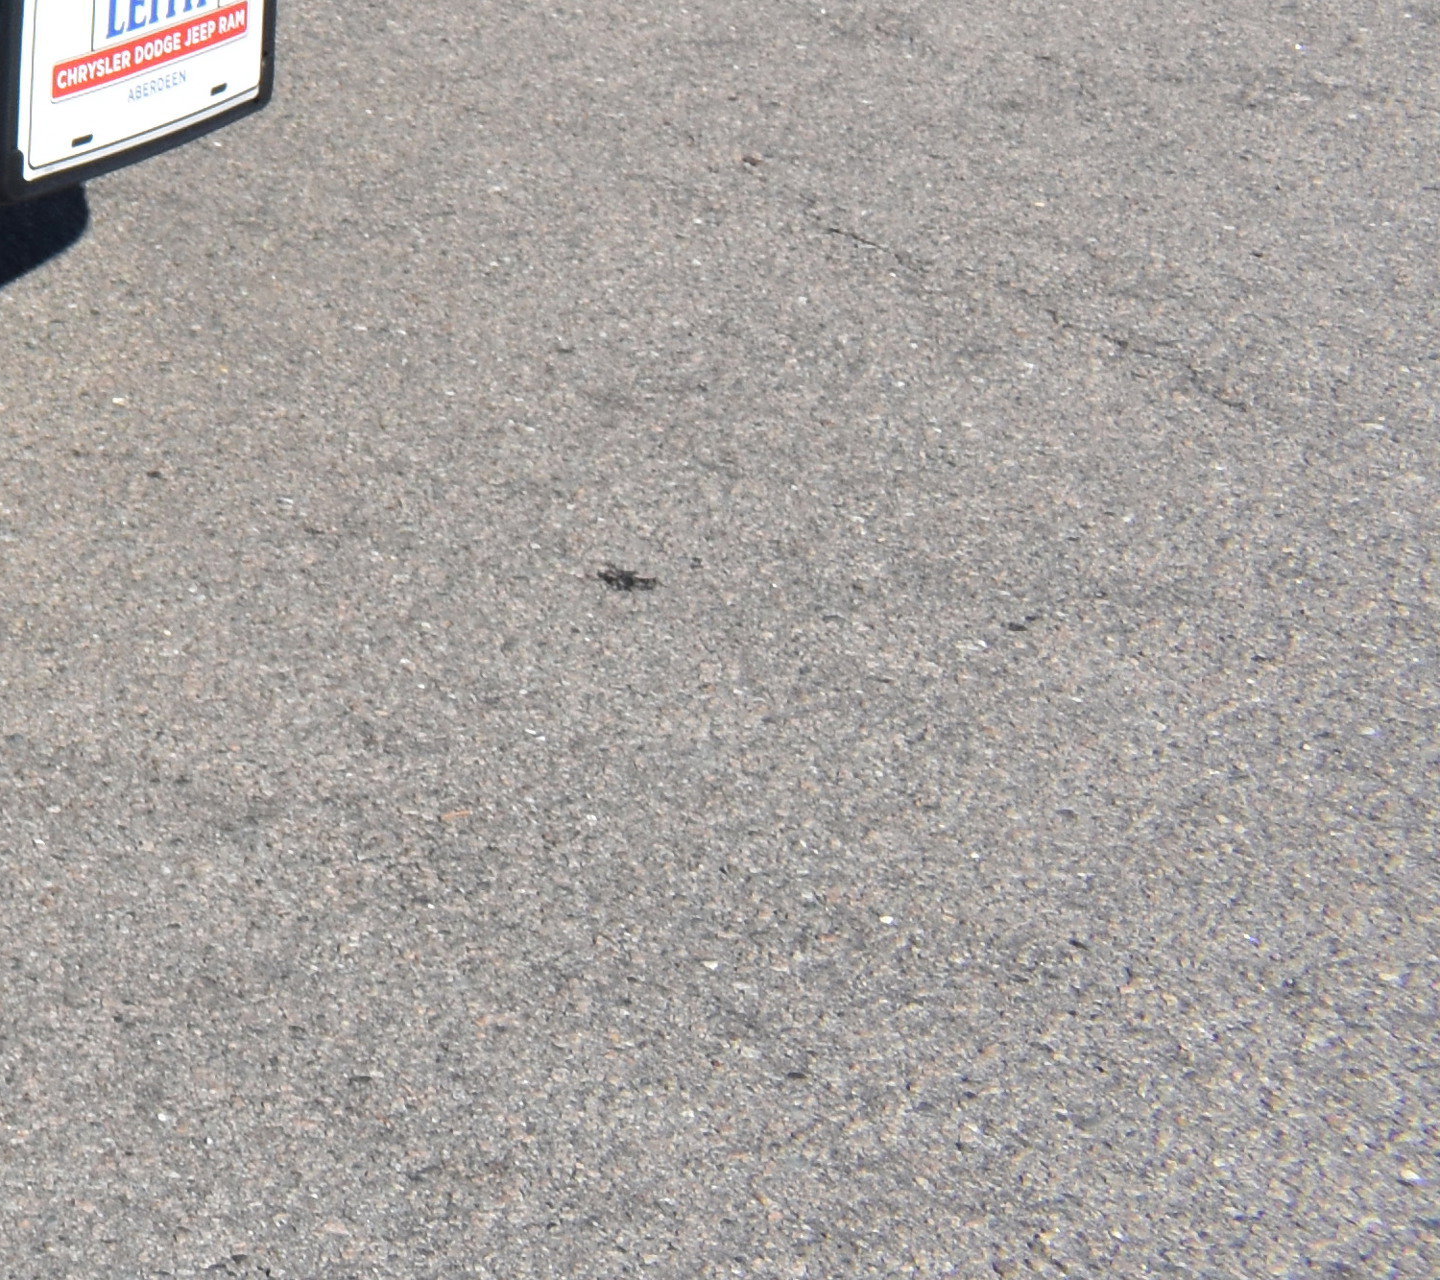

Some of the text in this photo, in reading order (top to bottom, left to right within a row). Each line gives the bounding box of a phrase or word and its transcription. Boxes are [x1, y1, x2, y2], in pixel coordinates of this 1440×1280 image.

[56, 8, 245, 89] CHRYSLER DODGE JEEP RAM
[127, 69, 187, 103] ABERDEEN
